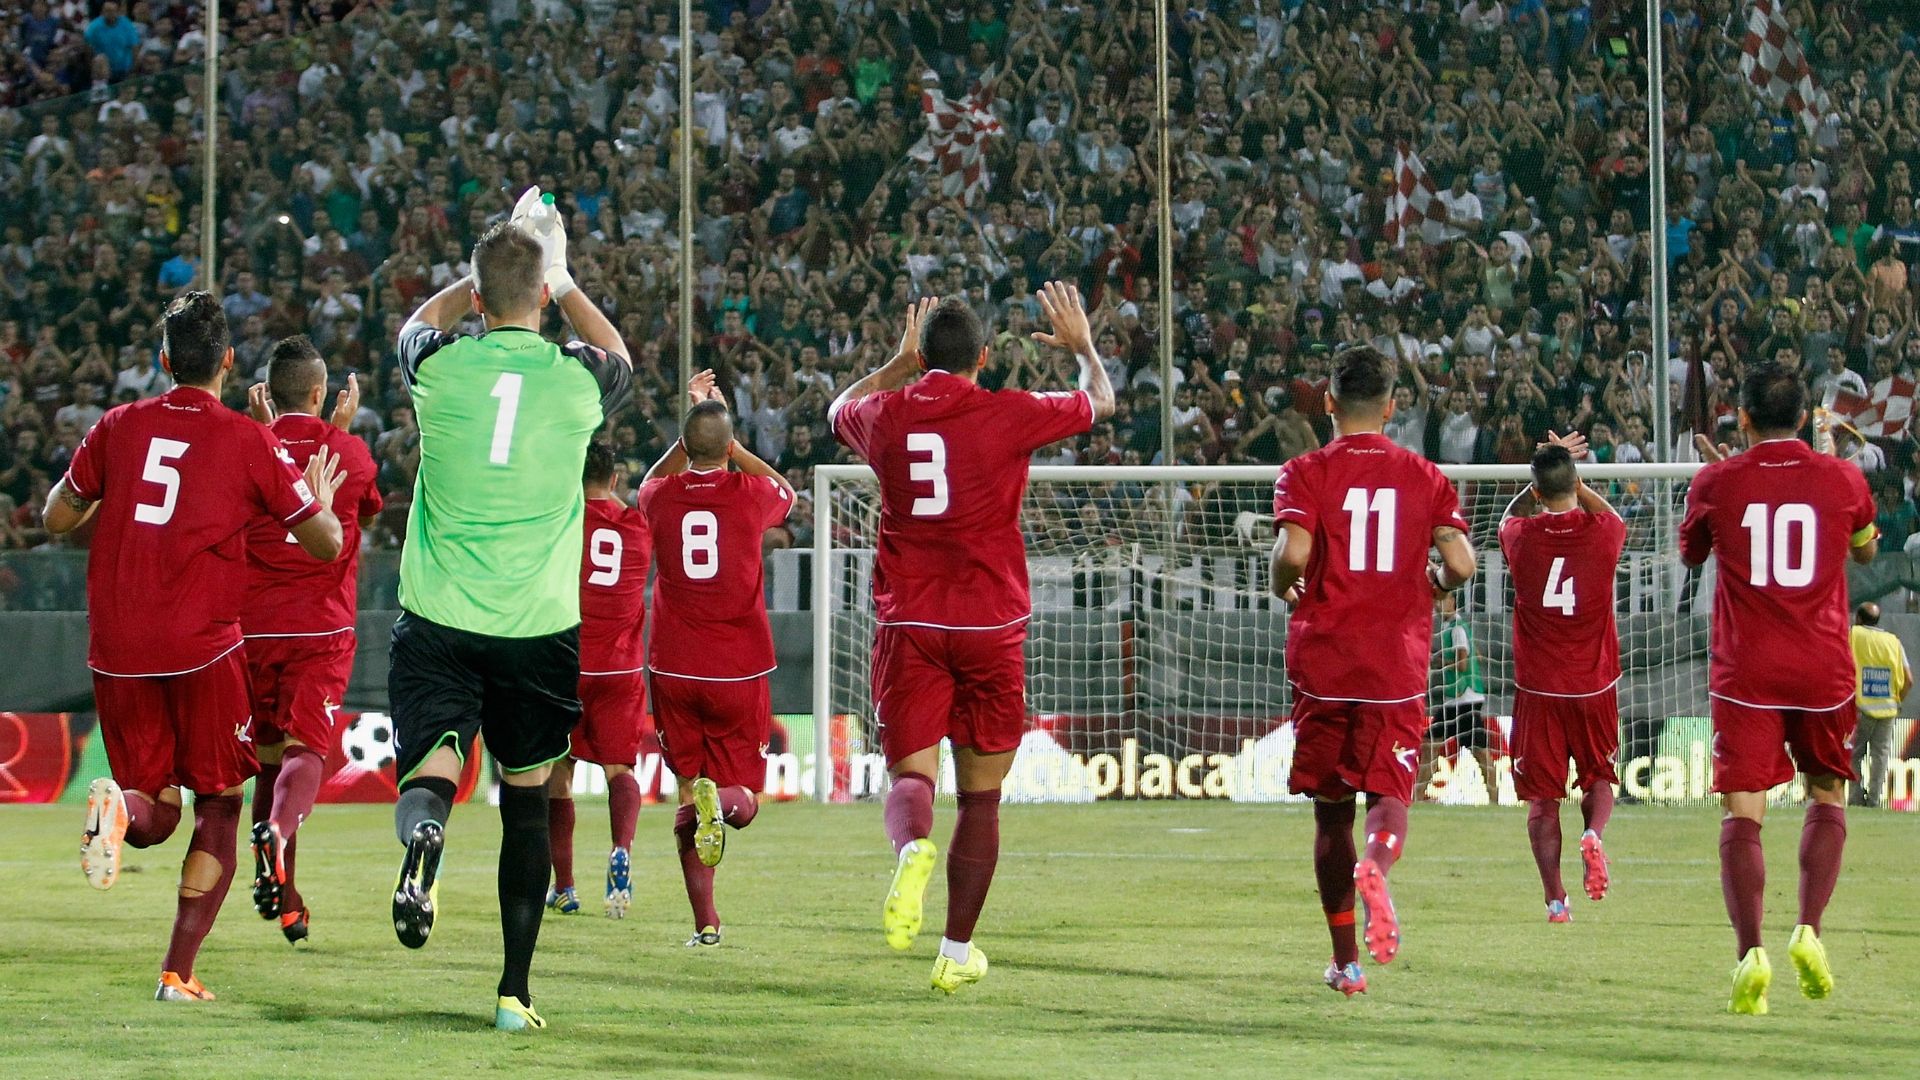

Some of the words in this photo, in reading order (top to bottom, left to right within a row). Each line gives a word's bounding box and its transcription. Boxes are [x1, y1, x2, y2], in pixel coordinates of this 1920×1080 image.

[489, 372, 523, 465] 1
[134, 437, 191, 525] 5
[907, 433, 949, 516] 3
[587, 528, 623, 587] 9
[681, 510, 719, 580] 8
[1342, 487, 1396, 573] 11
[1741, 503, 1817, 588] 10
[1542, 557, 1576, 616] 4
